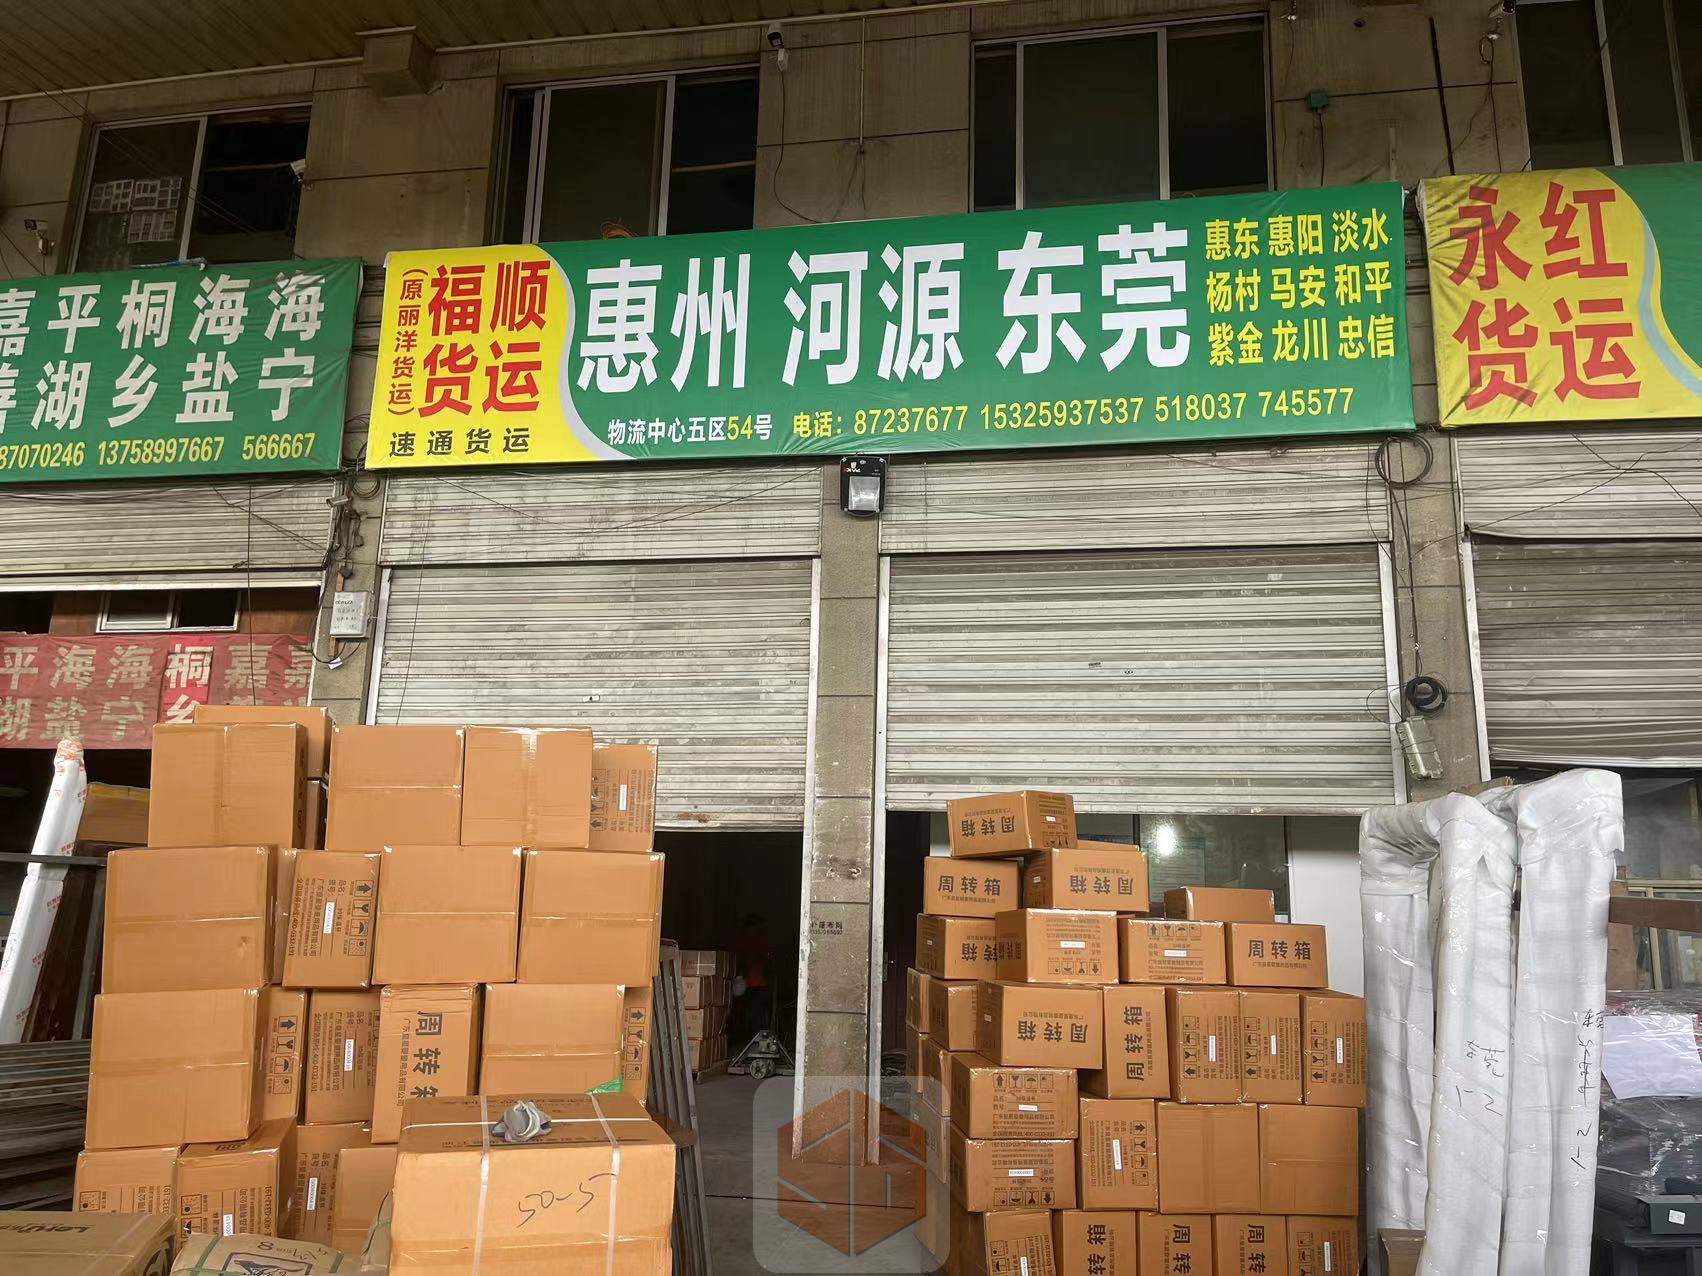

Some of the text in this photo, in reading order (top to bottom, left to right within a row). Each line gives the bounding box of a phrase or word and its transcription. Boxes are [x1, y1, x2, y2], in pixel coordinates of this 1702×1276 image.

[1205, 209, 1390, 260] 惠东 惠阳 淡水
[1448, 181, 1628, 291] 永红
[428, 260, 551, 337] 福顺
[577, 222, 1192, 394] 惠州 河源 东莞
[1206, 261, 1392, 313] 杨村 马安 和平
[1208, 314, 1394, 366] 紫金 龙川 忠信
[1452, 297, 1641, 410] 货运
[418, 340, 541, 418] 货运
[389, 427, 531, 457] 速通货运
[608, 414, 773, 446] 物流中心五区54号
[853, 404, 968, 435] 87237677
[981, 397, 1144, 431] 15325937537
[1155, 391, 1248, 425] 518037
[1259, 387, 1355, 419] 745577
[98, 436, 225, 465] 13758997667
[242, 432, 316, 461] 566667
[961, 815, 1015, 837] 周转箱
[938, 875, 1001, 896] 周转箱
[1070, 875, 1133, 895] 周转箱
[1245, 940, 1312, 960] 周转箱
[1018, 1020, 1088, 1043] 周转箱
[1124, 1006, 1144, 1081] 周转箱
